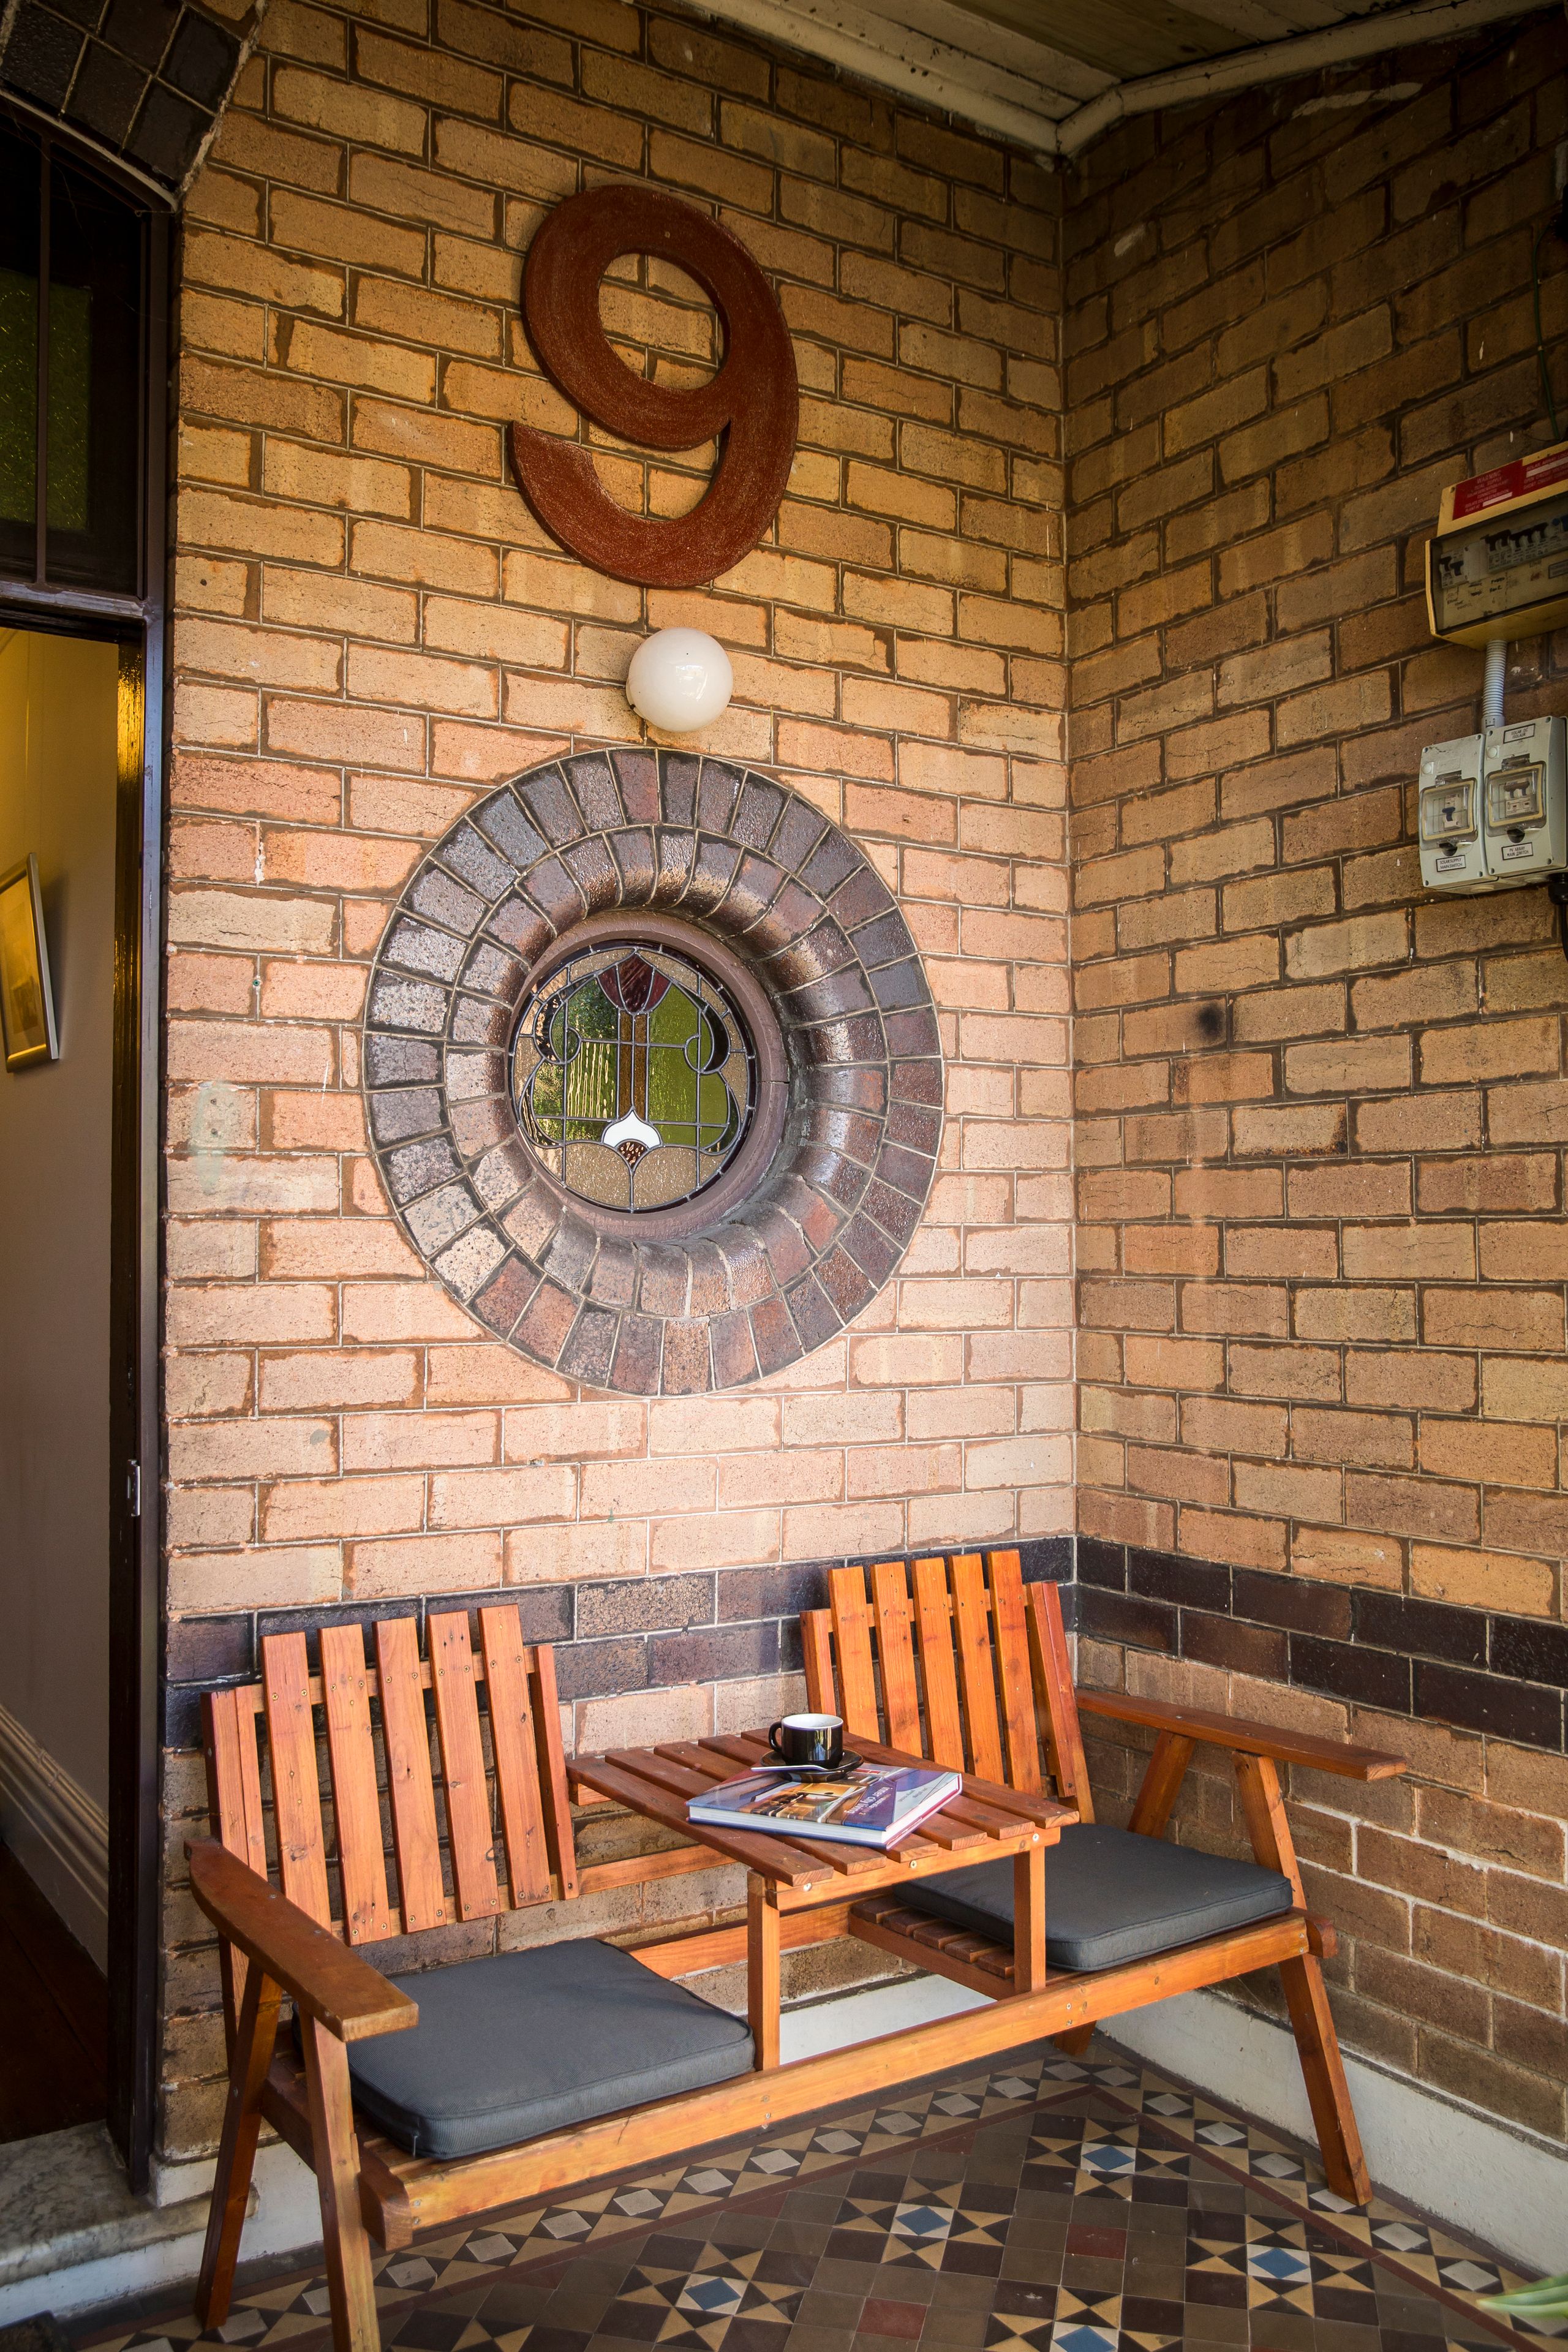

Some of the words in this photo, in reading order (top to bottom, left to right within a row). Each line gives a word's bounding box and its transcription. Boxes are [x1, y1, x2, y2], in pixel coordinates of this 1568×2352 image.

[508, 184, 800, 589] 9
[1477, 470, 1502, 484] WARNING
[870, 1786, 893, 1797] inner
[843, 1803, 869, 1814] living
